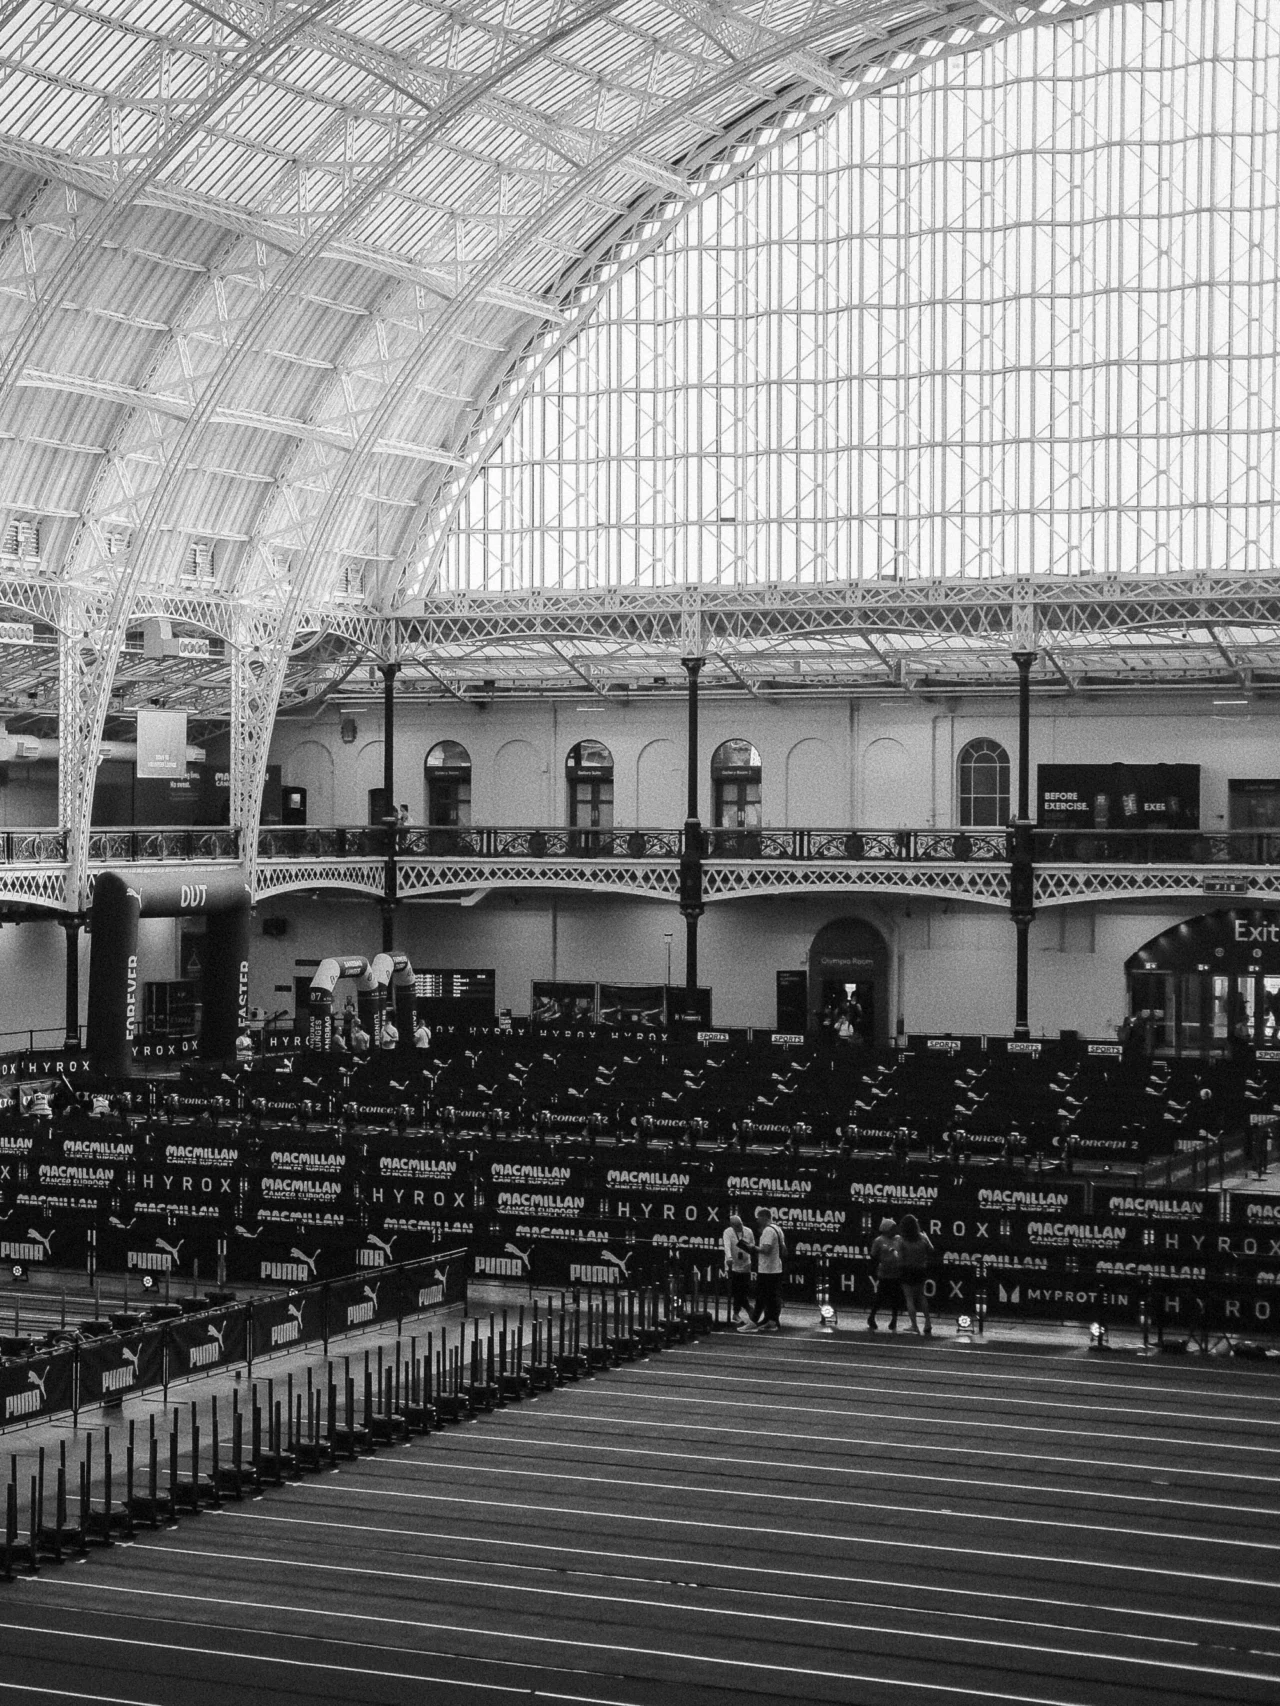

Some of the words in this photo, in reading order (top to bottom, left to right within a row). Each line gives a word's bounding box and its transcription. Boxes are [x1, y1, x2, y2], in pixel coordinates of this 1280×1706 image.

[1044, 792, 1078, 800] BEFORE
[1044, 803, 1089, 811] EXERCISE.
[1235, 920, 1280, 942] Exit
[126, 956, 138, 1040] FOREVER
[238, 961, 249, 1027] FASTER
[1009, 1044, 1040, 1052] SPORTS
[1090, 1046, 1122, 1054] SPORTS
[28, 1062, 90, 1073] HYROX
[63, 1140, 133, 1155] MACMILLAN
[166, 1145, 238, 1160] MACMILLAN
[271, 1151, 345, 1166] MACMILLAN
[379, 1157, 456, 1173] MACMILLAN
[39, 1165, 114, 1180] MACMILLAN
[491, 1163, 570, 1179] MACMILLAN
[607, 1169, 689, 1185] MACMILLAN
[144, 1174, 231, 1193] HYROX
[261, 1177, 342, 1194] MACMILLAN
[727, 1175, 812, 1192] MACMILLAN
[850, 1182, 938, 1198] MACMILLAN
[373, 1188, 464, 1208] HYROX
[498, 1192, 584, 1209] MACMILLAN
[978, 1189, 1068, 1206] MACMILLAN
[1109, 1197, 1203, 1214] MACMILLAN
[618, 1202, 720, 1222] HYROX
[1027, 1222, 1126, 1239] MACMILLAN
[1, 1241, 43, 1261] PUMA
[1166, 1234, 1280, 1255] HYROX
[128, 1252, 172, 1270] PUMA
[475, 1256, 521, 1276] PUMA
[261, 1261, 308, 1281] PUMA
[571, 1264, 619, 1284] PUMA
[1096, 1261, 1206, 1280] MACMILLAN
[841, 1273, 963, 1298] HYOX
[347, 1302, 374, 1325] PUMA
[271, 1321, 299, 1347] PUMA
[189, 1343, 220, 1369] PUMA
[102, 1368, 133, 1394] PUMA
[5, 1391, 40, 1420] PUMA
